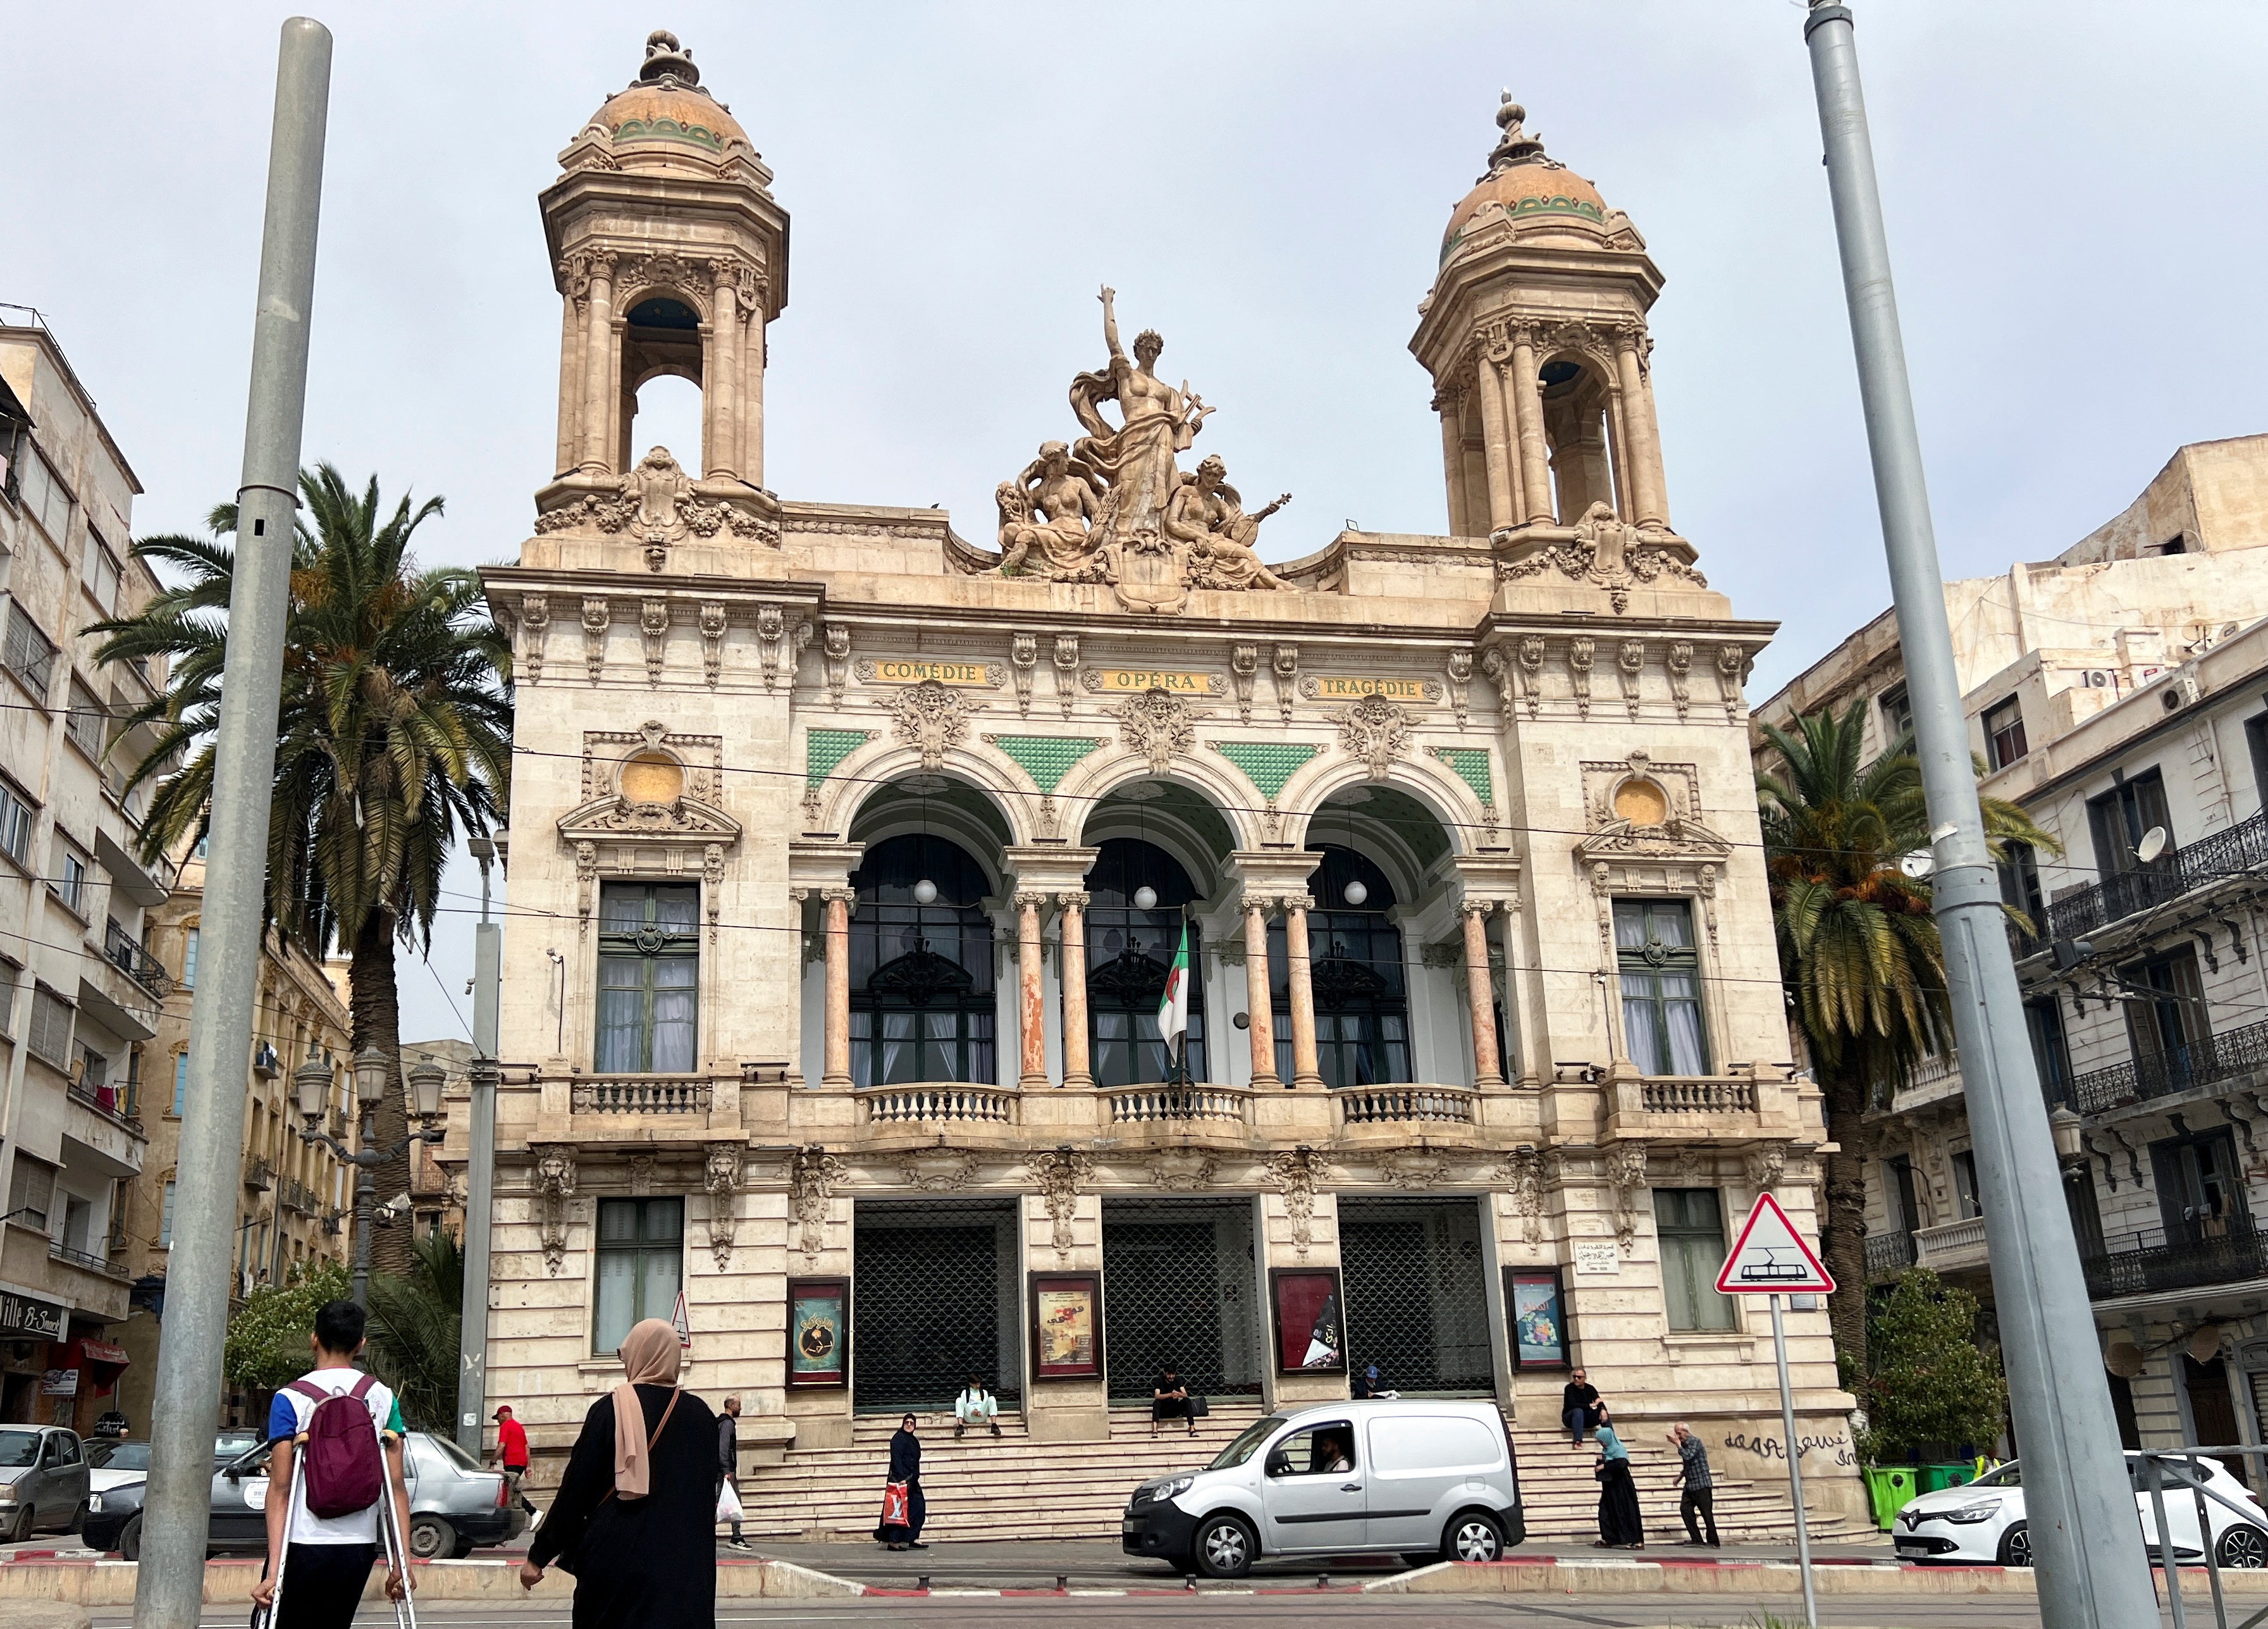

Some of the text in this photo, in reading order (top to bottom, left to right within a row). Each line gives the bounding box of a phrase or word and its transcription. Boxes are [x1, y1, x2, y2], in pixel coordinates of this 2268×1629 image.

[884, 663, 976, 680] COMÉDIE
[1118, 672, 1195, 688] OPÉRA
[1324, 679, 1416, 695] TRAGÉDIE
